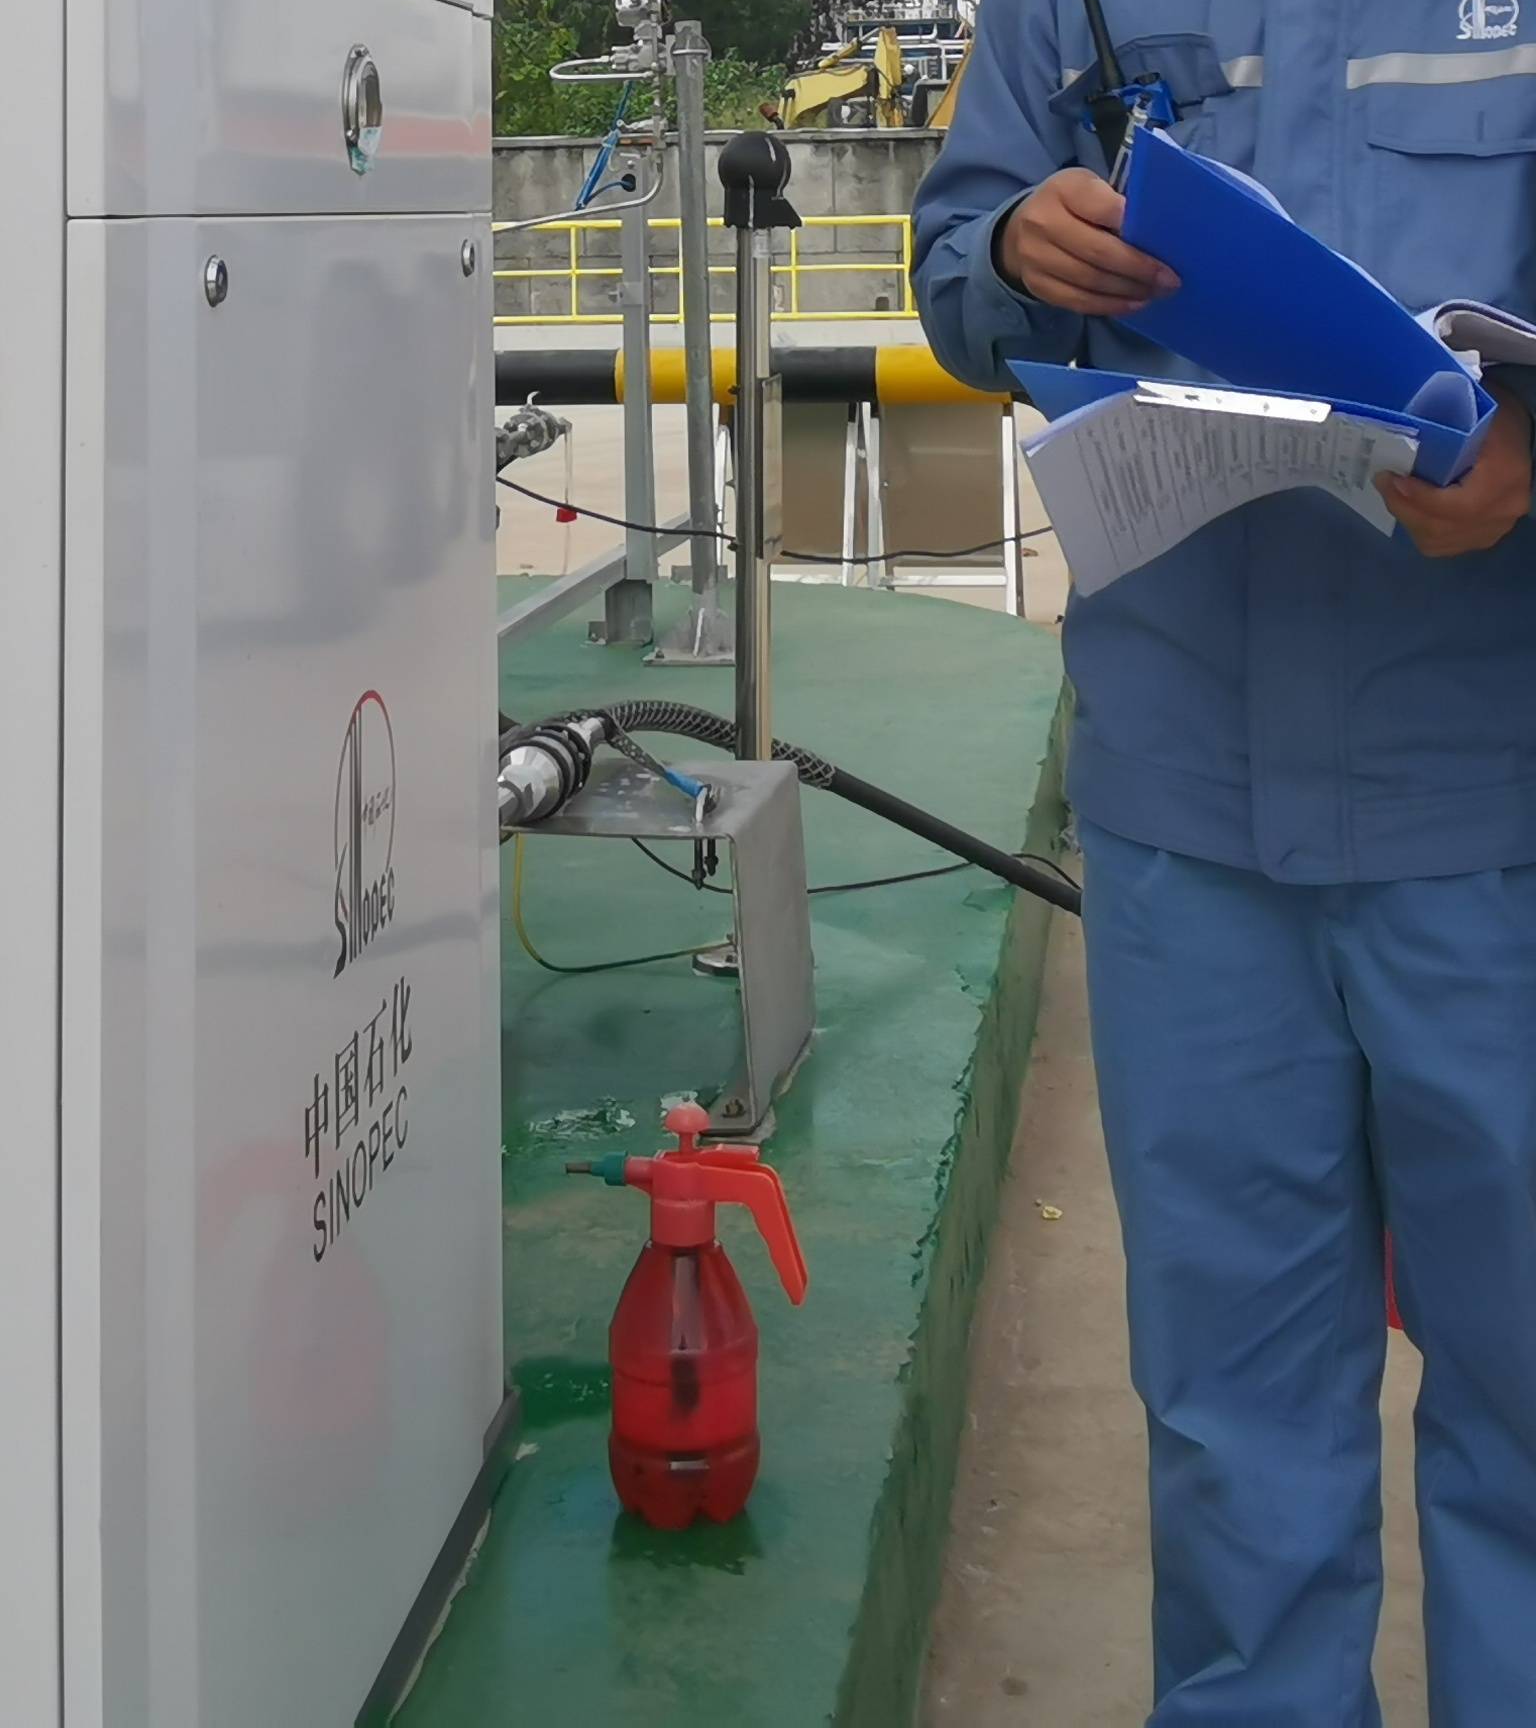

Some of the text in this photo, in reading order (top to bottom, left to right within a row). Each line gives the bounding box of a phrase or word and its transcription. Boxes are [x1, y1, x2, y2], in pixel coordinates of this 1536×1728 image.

[304, 975, 414, 1179] 中国石化
[311, 1086, 410, 1264] SINOPEC
